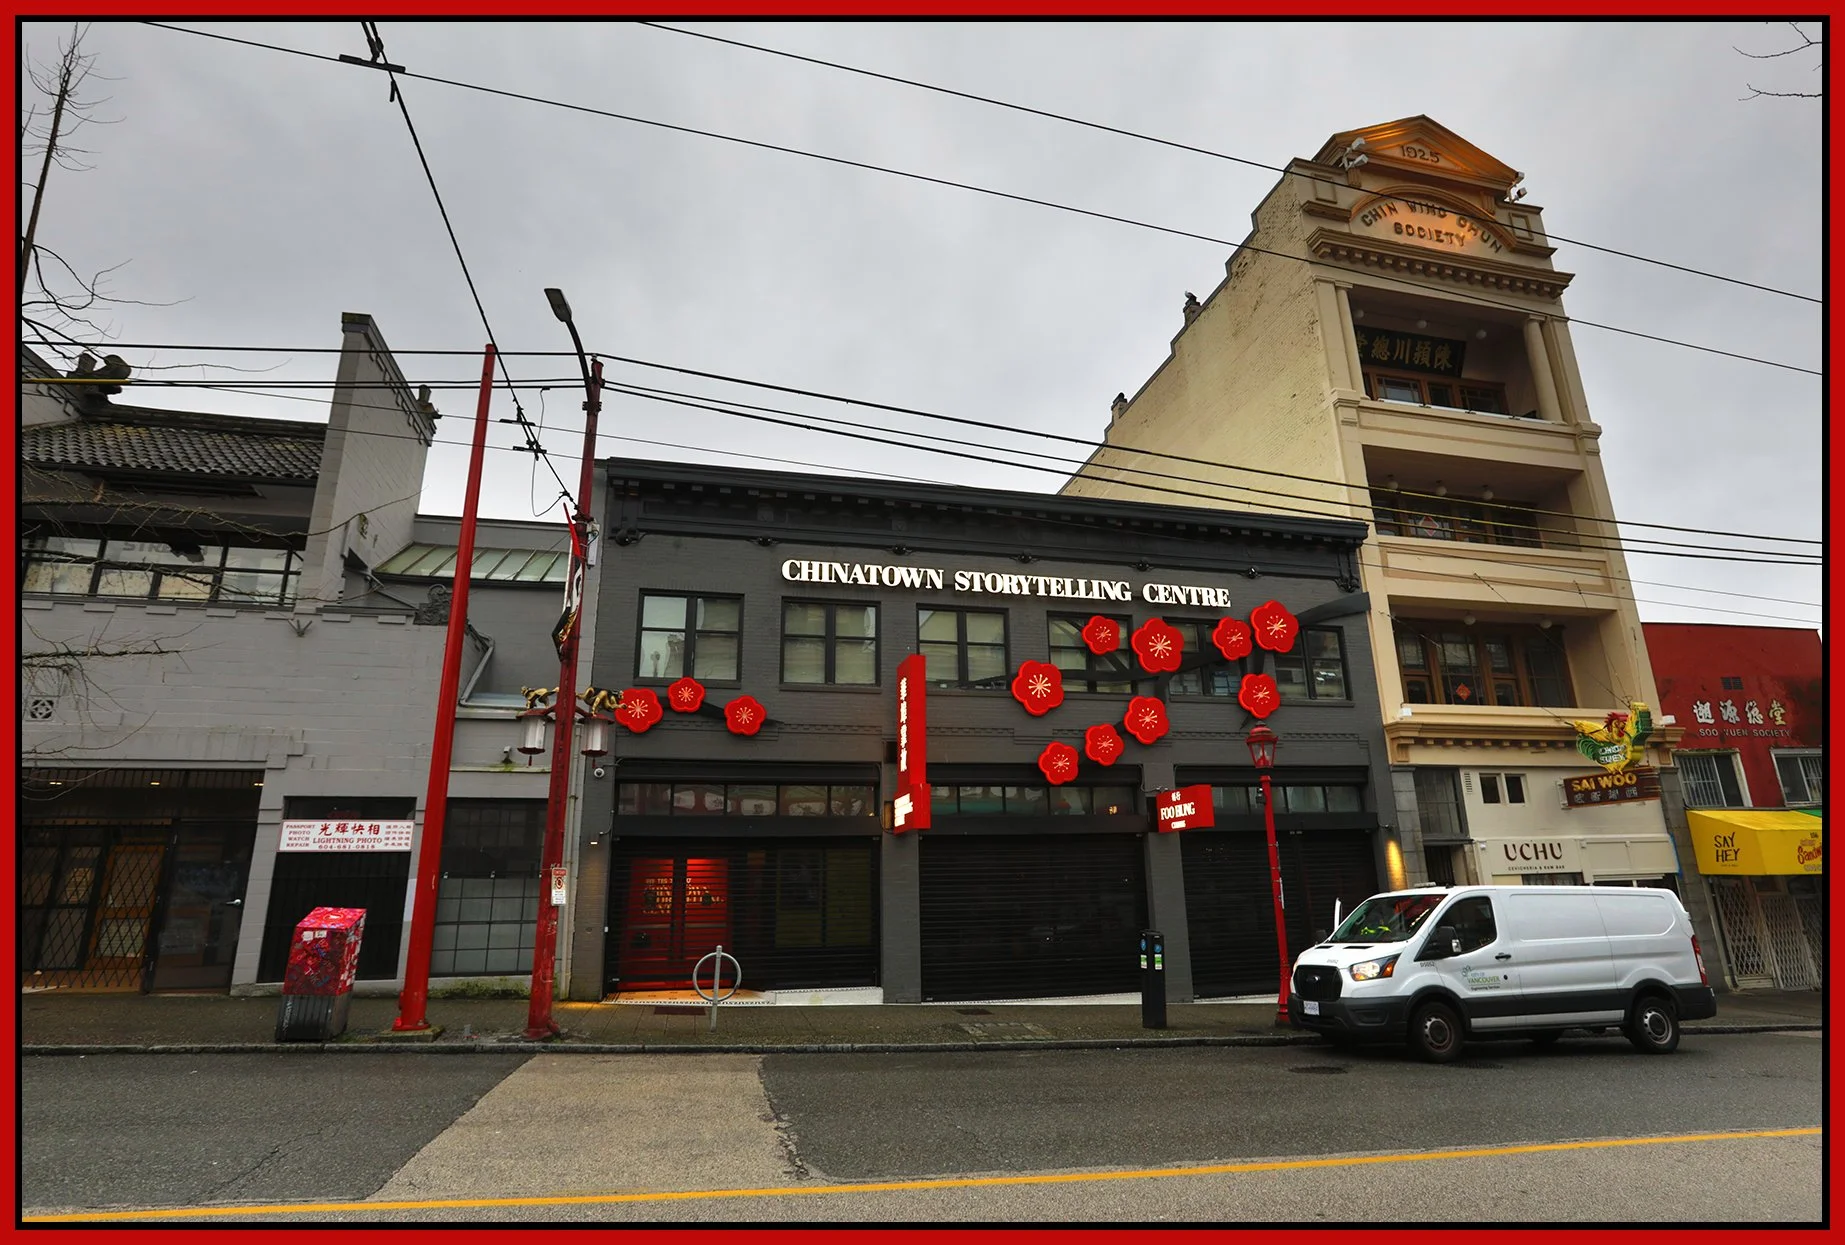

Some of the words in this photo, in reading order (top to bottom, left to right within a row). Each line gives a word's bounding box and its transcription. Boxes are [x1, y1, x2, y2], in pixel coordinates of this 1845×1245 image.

[1401, 145, 1440, 164] 1925
[1361, 202, 1398, 228] CHIN
[1456, 216, 1502, 253] CHUN
[1394, 222, 1466, 247] SOCIETY
[781, 559, 943, 590] CHINATOWN
[954, 571, 1133, 602] STORYTELLING
[1143, 583, 1231, 608] CENTRE
[1699, 728, 1719, 737] SOO
[1724, 729, 1749, 737] YUEN
[1752, 729, 1791, 738] SOCIETY
[1571, 778, 1596, 792] SAI
[1598, 772, 1637, 789] WOO
[1160, 806, 1174, 820] FOO
[1175, 802, 1195, 817] HUNG
[1714, 832, 1735, 848] SAY
[1503, 842, 1563, 861] UCHU
[1716, 848, 1740, 863] HEY
[1467, 975, 1500, 984] VANCOUVER
